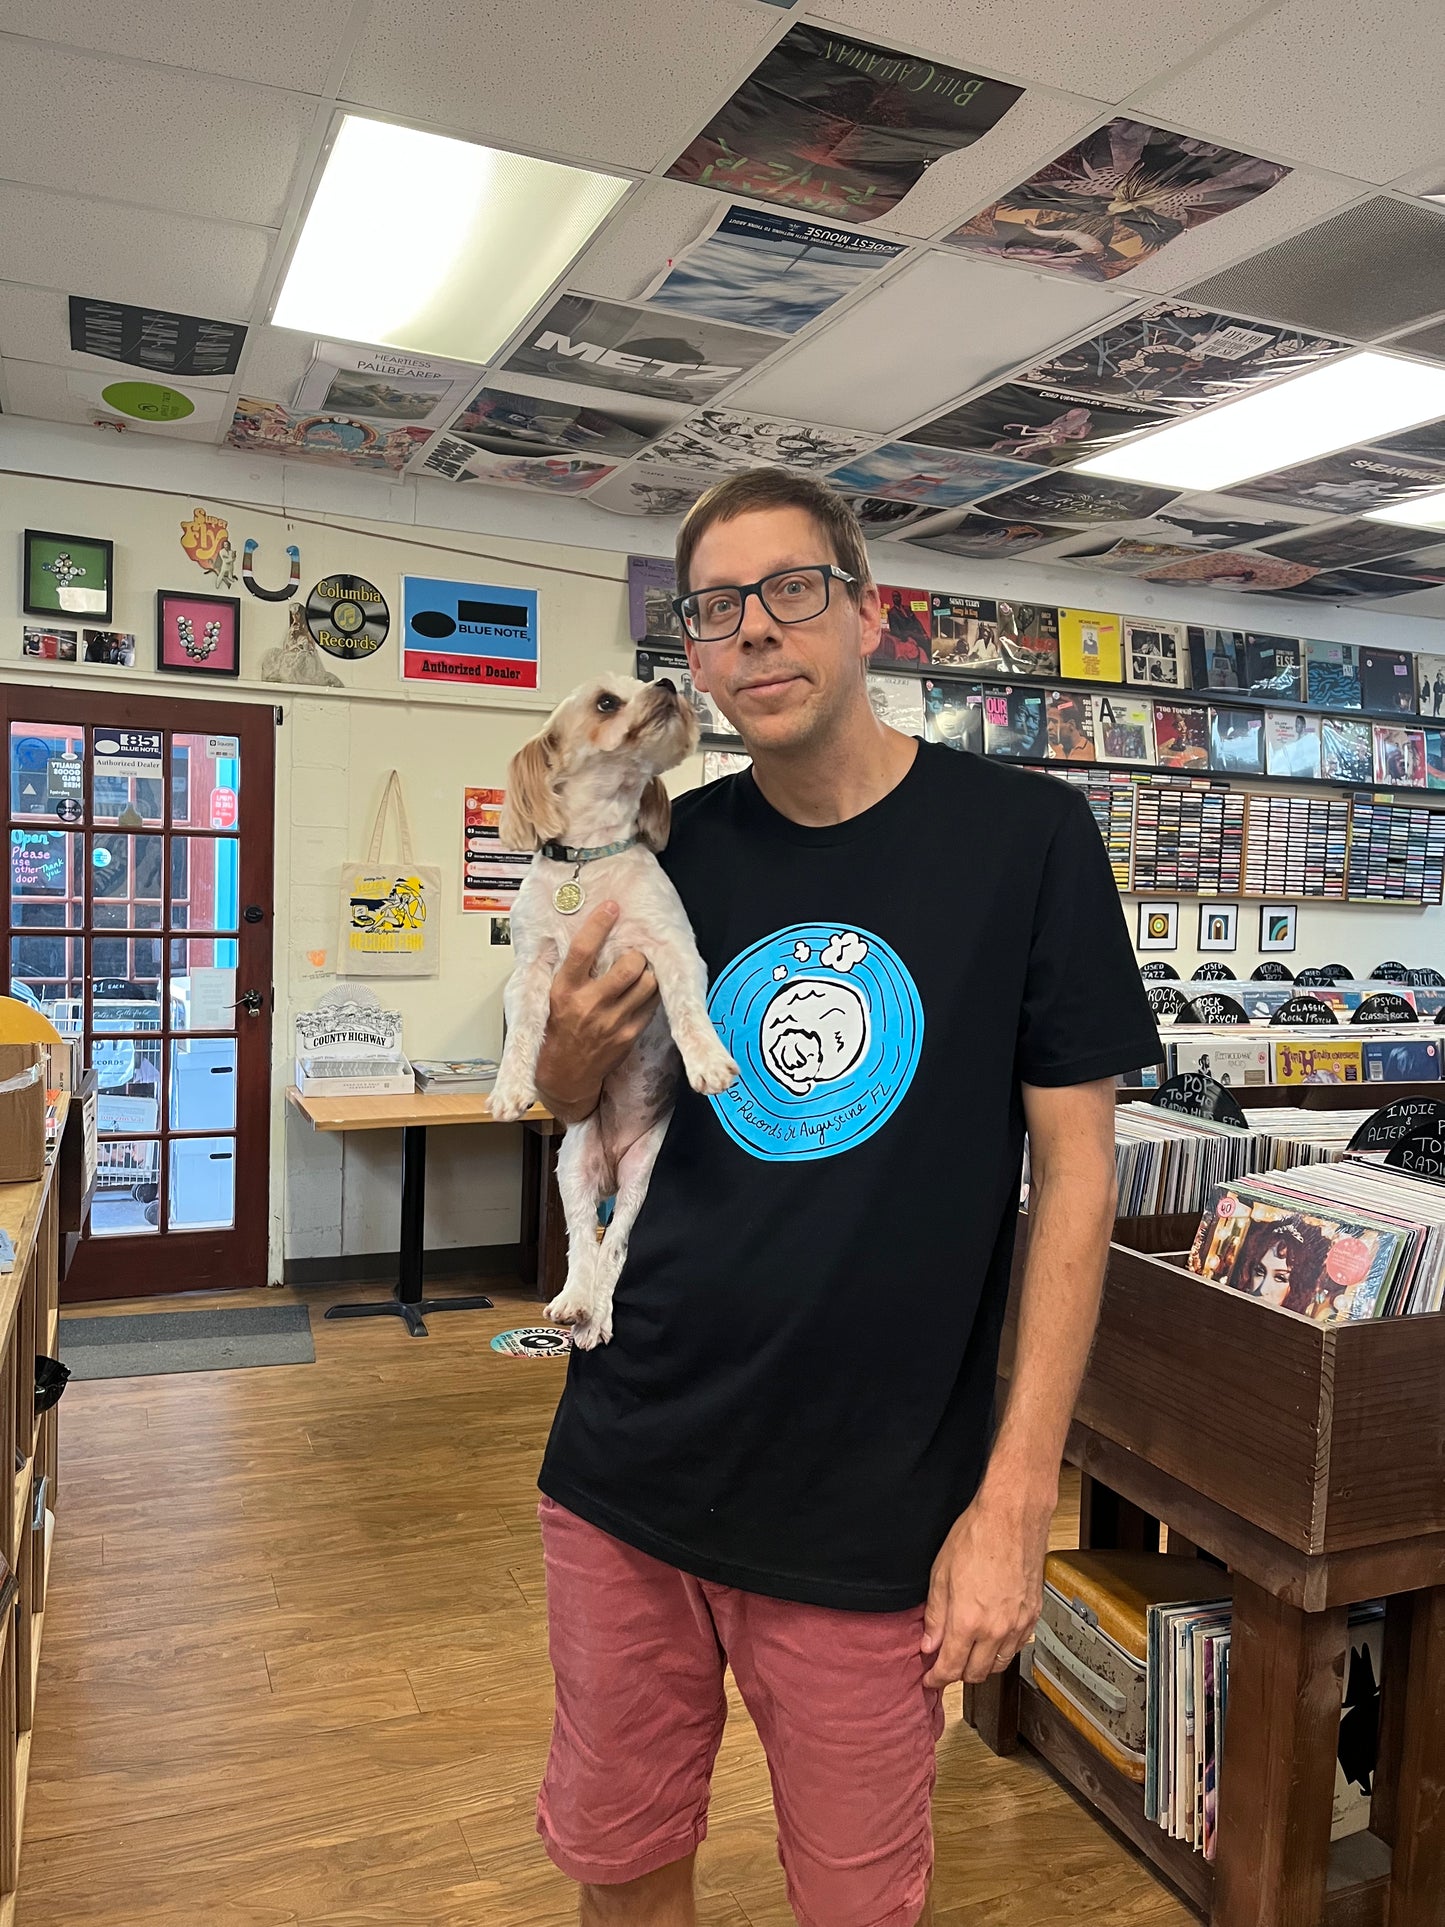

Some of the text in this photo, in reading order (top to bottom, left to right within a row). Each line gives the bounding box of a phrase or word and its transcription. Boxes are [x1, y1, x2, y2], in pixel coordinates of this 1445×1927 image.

[806, 226, 902, 253] MODEST MOUSE
[375, 354, 431, 369] HEARTLESS
[532, 331, 743, 382] METZ
[193, 508, 228, 529] Super
[181, 521, 229, 559] Fly
[317, 581, 382, 603] Columbia
[459, 624, 529, 639] BLUE NOTE
[318, 631, 378, 650] Records
[1275, 654, 1295, 667] ELSE
[421, 660, 521, 680] Authorized Dealer
[986, 697, 1008, 713] OUR
[987, 712, 1008, 726] THING
[122, 734, 159, 747] 85
[96, 759, 136, 768] Authorized
[11, 829, 50, 852] Open
[12, 846, 51, 859] Please
[12, 859, 30, 867] use
[15, 866, 38, 874] other
[16, 869, 61, 883] door you
[1143, 963, 1165, 971] USED
[1260, 963, 1284, 974] VOCAL
[1142, 971, 1166, 979] JAZZ
[1198, 970, 1227, 980] JAZZ
[1300, 977, 1331, 987] JAZZ
[1413, 973, 1442, 986] BLUES
[1162, 1002, 1186, 1014] PSYC
[1197, 997, 1221, 1007] ROCK
[1290, 1003, 1326, 1013] CLASSIC
[1372, 996, 1402, 1007] PSYCH
[1204, 1006, 1224, 1015] POP
[1208, 1014, 1238, 1024] PSYCH
[313, 1032, 387, 1047] COUNTY HIGHWAY
[1183, 1073, 1214, 1094] POP
[1160, 1097, 1188, 1114] RADIO
[1166, 1088, 1214, 1109] TOP 40
[737, 1100, 784, 1139] Records
[799, 1103, 868, 1145] Augustine
[870, 1082, 892, 1105] FL
[1386, 1103, 1438, 1118] INDIE
[1412, 1137, 1445, 1155] TO
[1401, 1150, 1445, 1175] RADI
